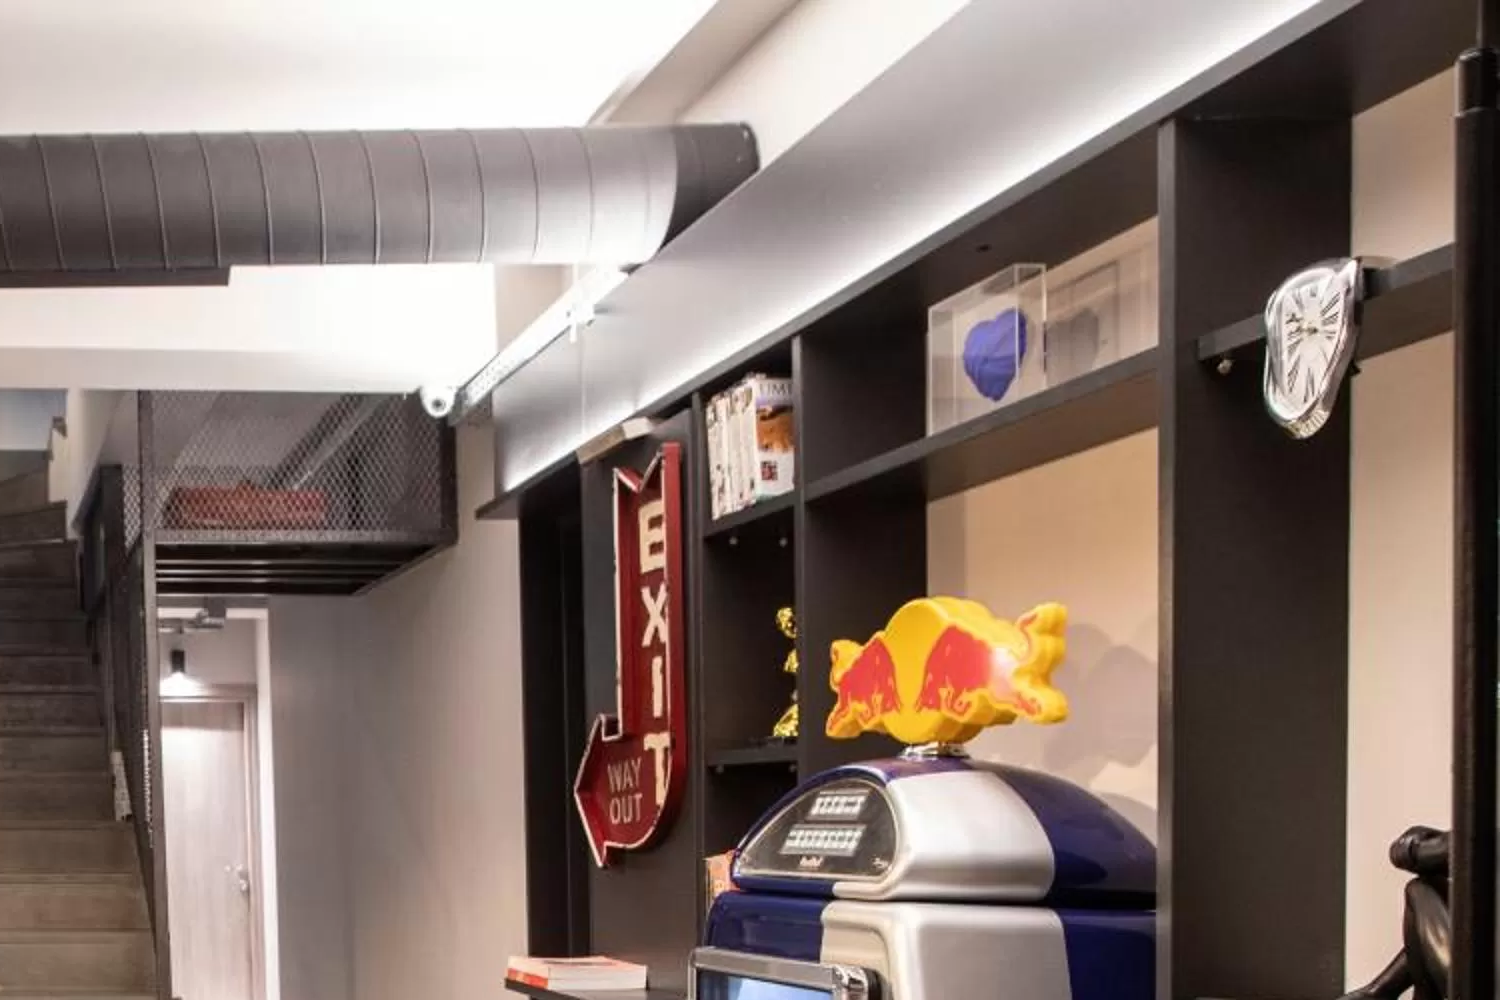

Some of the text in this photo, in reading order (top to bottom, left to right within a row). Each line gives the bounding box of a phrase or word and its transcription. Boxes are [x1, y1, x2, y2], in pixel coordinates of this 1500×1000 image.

[638, 501, 670, 808] EXIT
[607, 757, 642, 793] WAY
[609, 793, 643, 824] OUT
